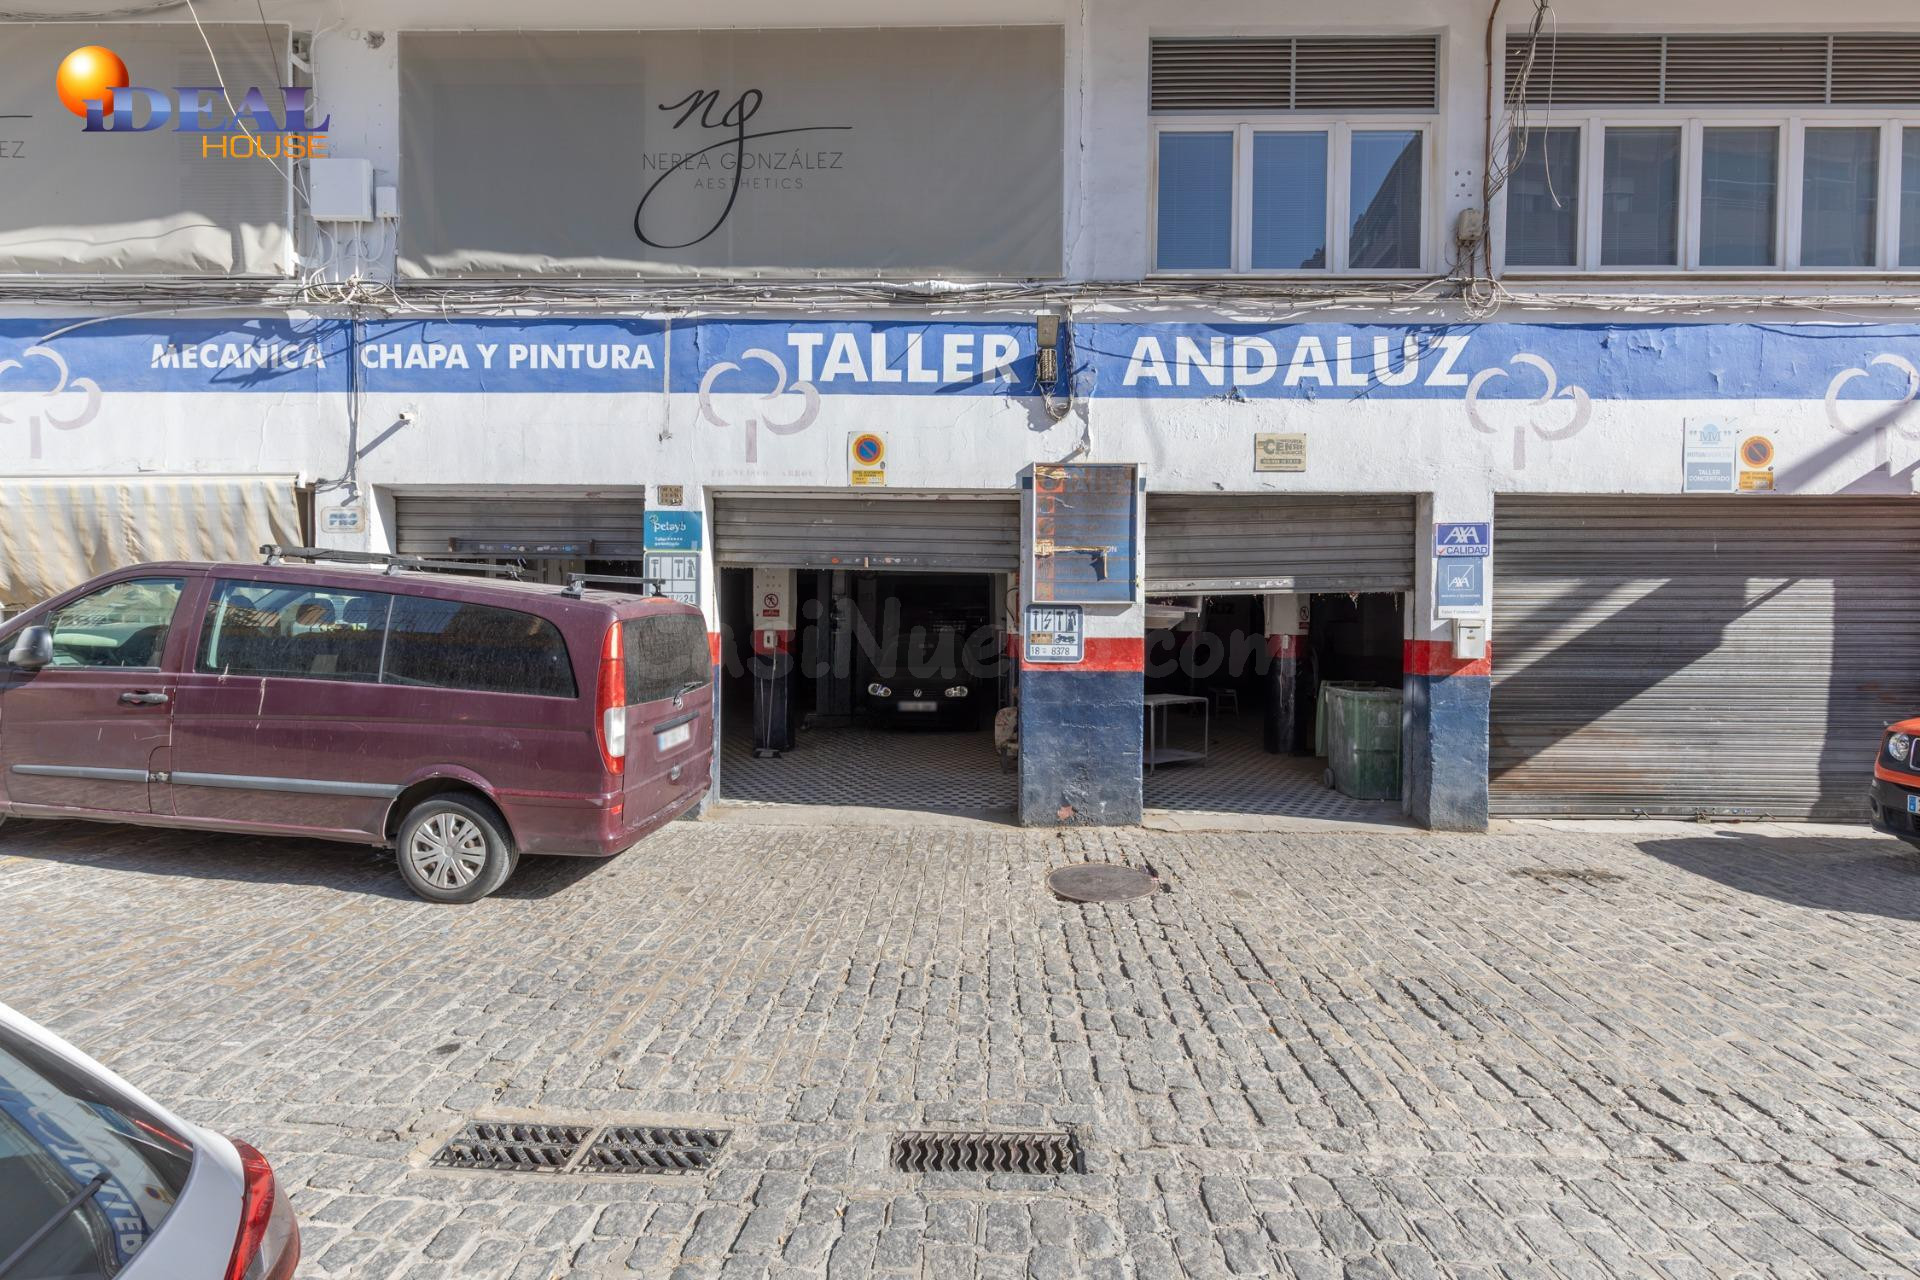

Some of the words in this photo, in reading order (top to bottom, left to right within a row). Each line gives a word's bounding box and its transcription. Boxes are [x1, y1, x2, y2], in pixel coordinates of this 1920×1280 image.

[642, 151, 711, 170] NEREA
[720, 148, 844, 170] GONZÁLEZ
[694, 177, 804, 190] AESTHETICS
[151, 343, 326, 369] MECANICA
[360, 344, 469, 369] CHAPA
[476, 344, 499, 369] Y
[509, 344, 656, 369] PINTURA
[787, 333, 1021, 384] TALLER
[1122, 335, 1472, 387] ANDALUZ
[1443, 526, 1481, 545] AXA
[1446, 546, 1488, 555] CALIDAD
[1449, 576, 1470, 588] AXA
